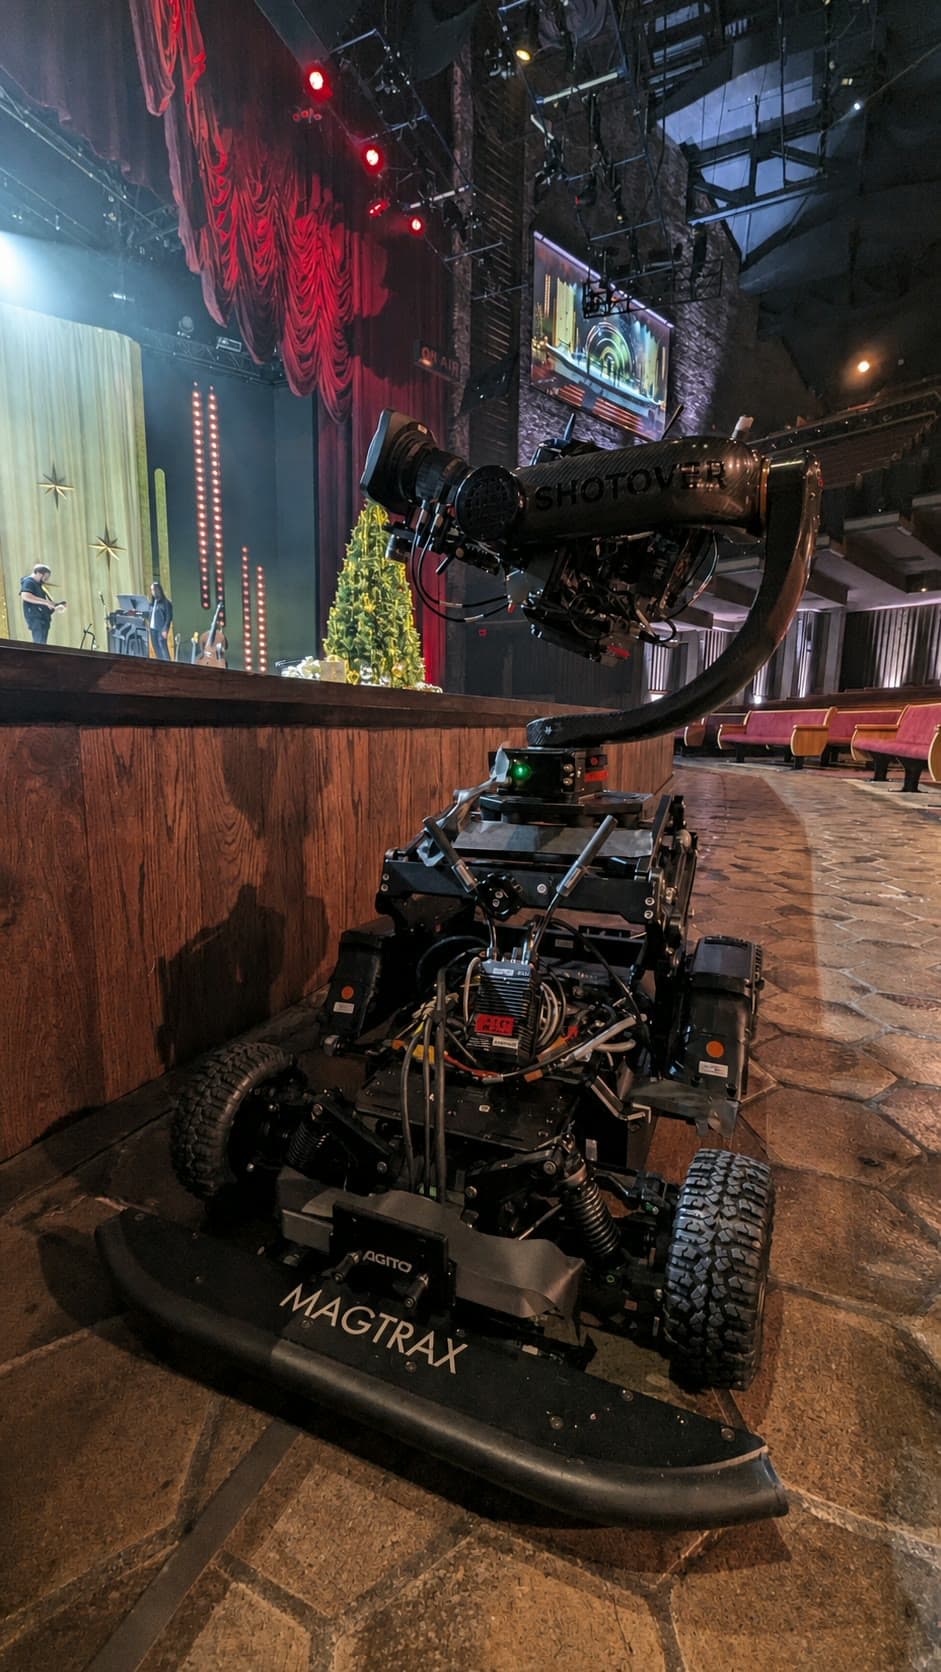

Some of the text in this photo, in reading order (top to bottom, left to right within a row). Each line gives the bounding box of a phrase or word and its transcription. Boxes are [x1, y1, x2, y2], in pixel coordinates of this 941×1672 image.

[421, 346, 460, 378] ON AIR
[535, 460, 726, 510] SHOTOVER
[363, 1250, 412, 1273] AGITO
[279, 1283, 469, 1374] MAGTRAX
